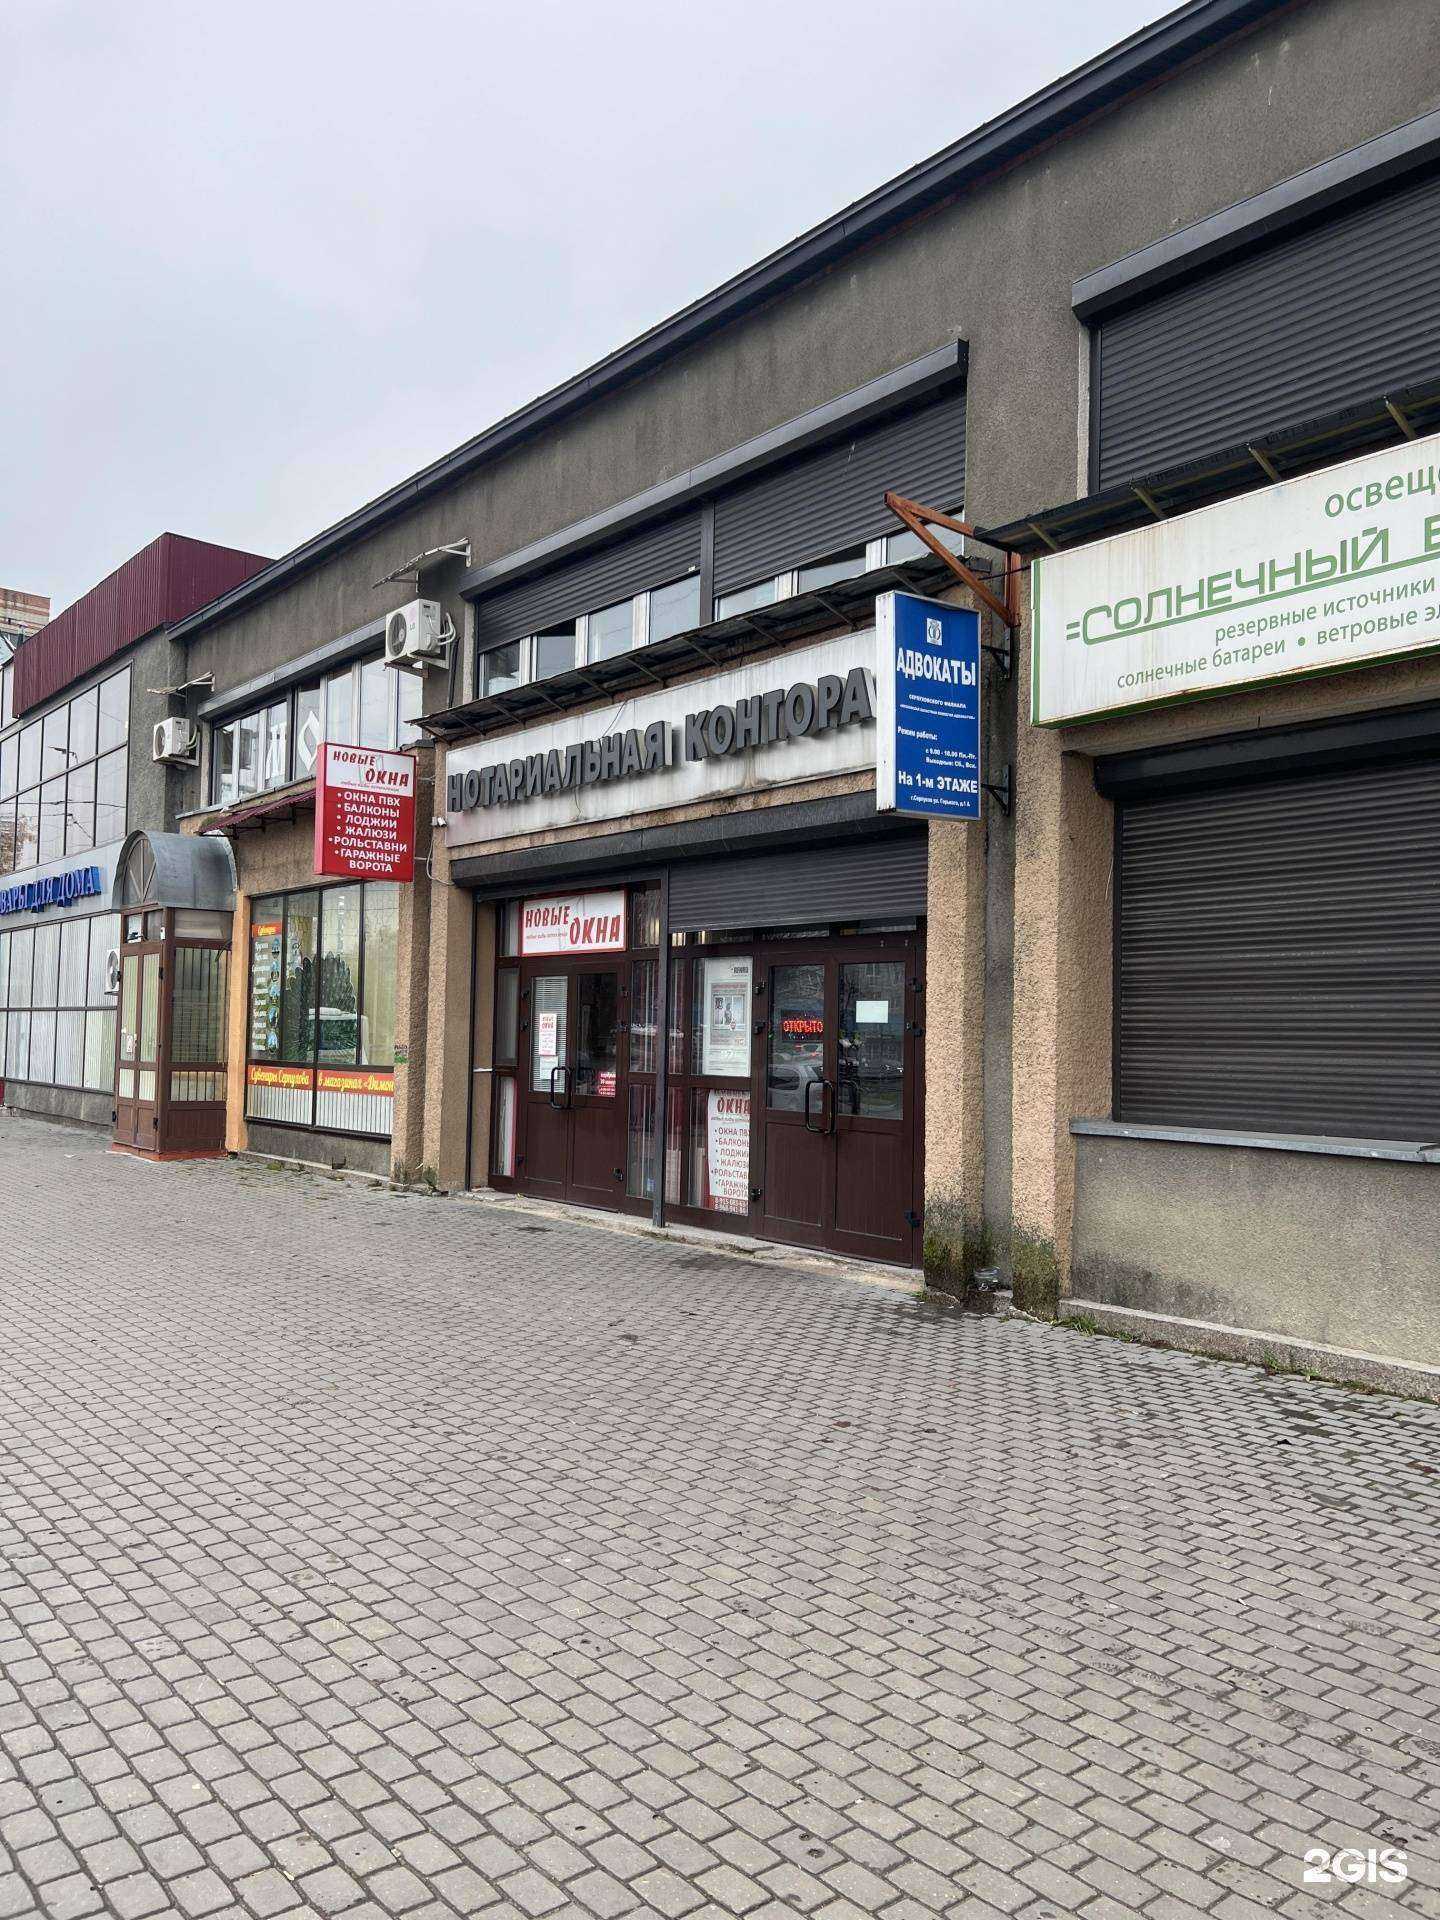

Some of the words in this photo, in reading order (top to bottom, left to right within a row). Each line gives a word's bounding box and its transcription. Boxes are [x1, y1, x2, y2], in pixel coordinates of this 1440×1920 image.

[1325, 465, 1440, 518] освещ
[1082, 526, 1389, 646] СОЛНЕЧНЫЙ
[1215, 605, 1317, 646] резервные
[1323, 577, 1435, 617] источники
[1117, 656, 1207, 689] солнечные
[1212, 638, 1285, 672] батареи
[1317, 609, 1418, 645] ветровые
[897, 647, 976, 686] АДВОКАТЫ
[448, 720, 671, 812] НОТАРИАЛЬНАЯ
[685, 667, 876, 761] КОНТОРА
[897, 726, 916, 736] Режим
[333, 751, 375, 766] НОВЫЕ
[365, 768, 409, 787] ОКНА
[898, 771, 913, 786] На
[916, 773, 934, 788] 1-м
[937, 776, 978, 793] ЭТАЖЕ
[344, 791, 376, 803] ОКНА
[379, 796, 400, 806] ПВХ
[344, 803, 400, 818] БАЛКОНЫ
[345, 815, 397, 829] ЛОДЖИИ
[345, 826, 397, 840] ЖАЛЮЗИ
[334, 836, 408, 853] РОЛЬСТАВНИ
[340, 848, 401, 863] ГАРАЖНЫЕ
[349, 861, 393, 873] ВОРОТА
[31, 877, 56, 910] ДЛЯ
[57, 867, 99, 906] ДОМА
[525, 905, 571, 928] НОВЫЕ
[569, 914, 621, 945] ОКНА
[783, 1019, 824, 1033] ОТКРЫТО
[718, 1126, 737, 1136] ОКНА
